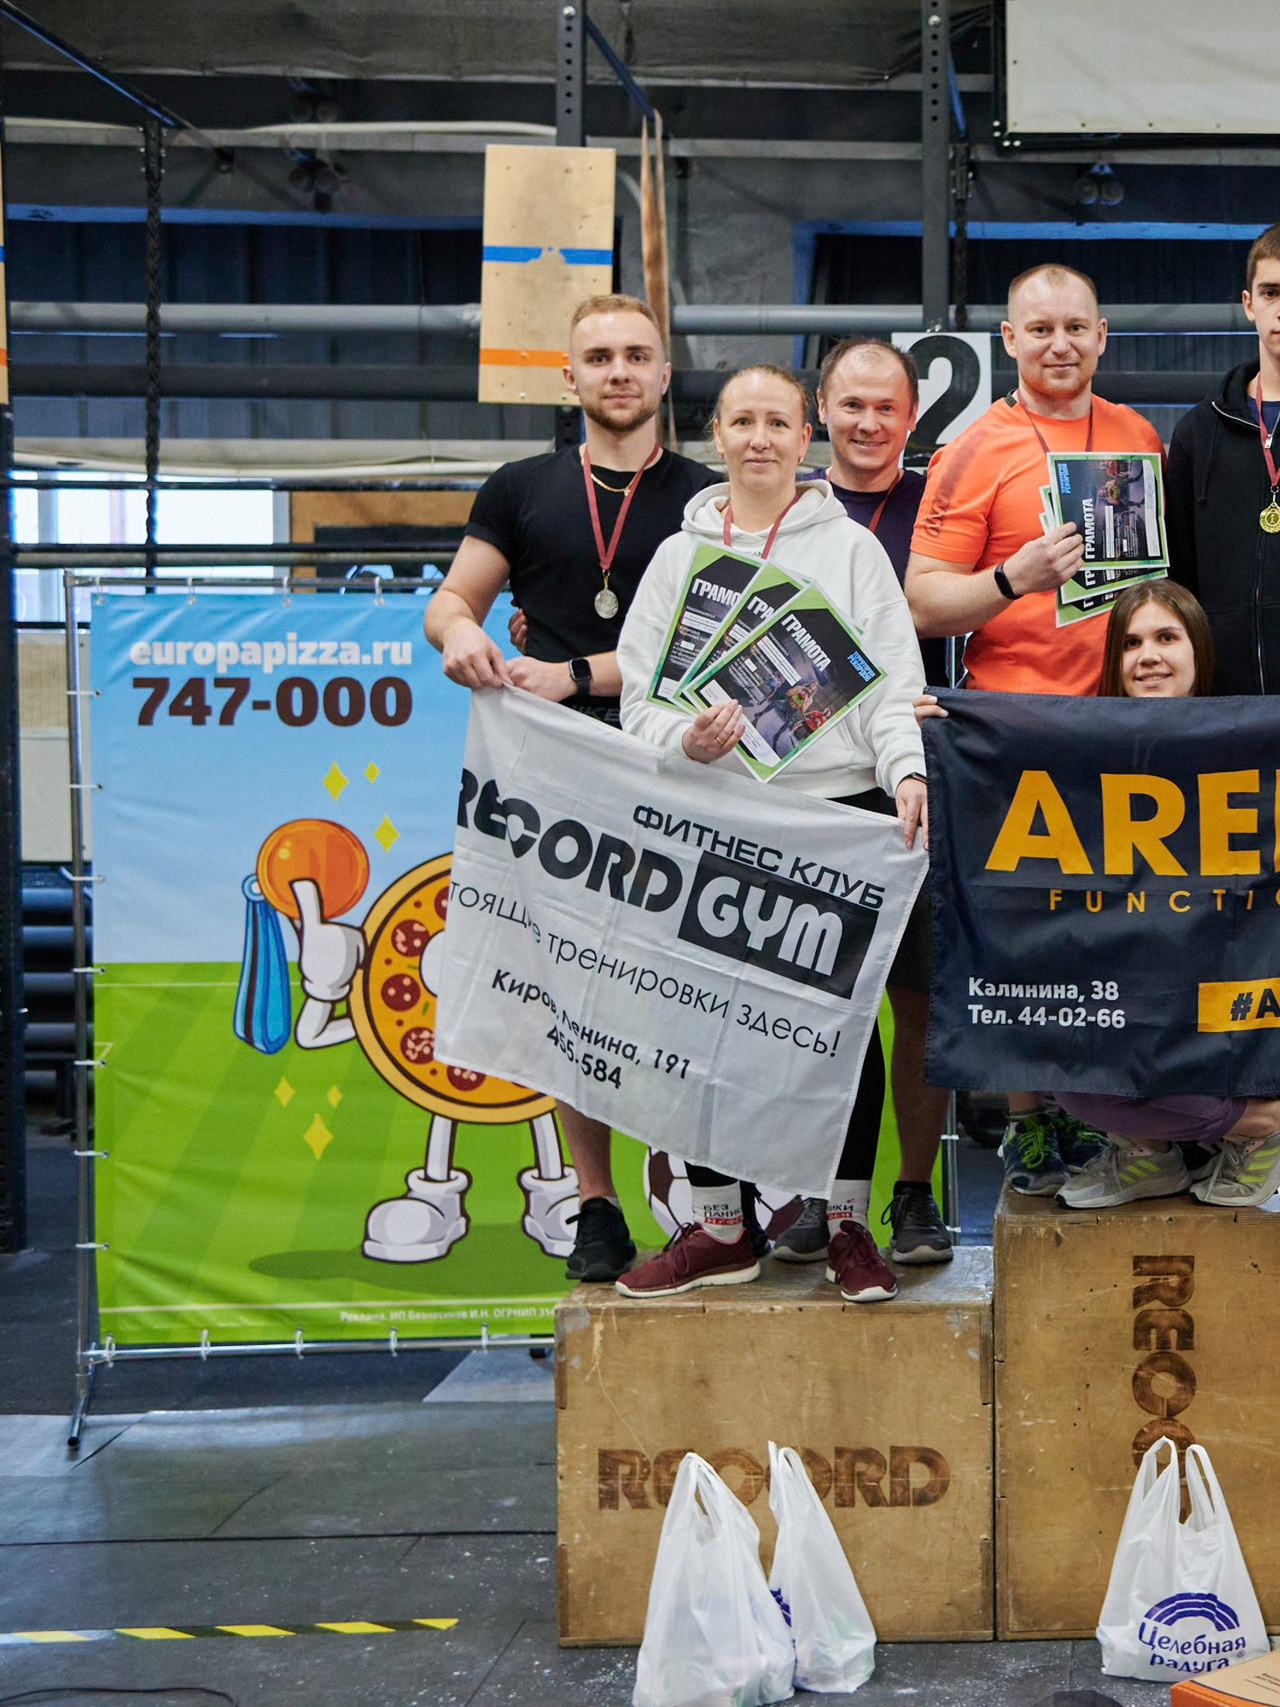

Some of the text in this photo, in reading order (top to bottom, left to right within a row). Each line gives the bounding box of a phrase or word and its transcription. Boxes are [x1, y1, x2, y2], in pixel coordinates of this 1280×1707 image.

[903, 335, 981, 467] 2
[1081, 497, 1096, 560] ГРАМОТА
[690, 578, 743, 606] ГРАМО
[130, 632, 412, 674] europapizza.ru
[780, 613, 833, 672] ГРАМОТА
[132, 676, 413, 727] 747-000
[633, 804, 886, 910] ФИТНЕС КЛУБ
[548, 932, 730, 1019] тренировки
[736, 1003, 842, 1058] здесь!
[967, 977, 1120, 1003] Калинина, 38
[491, 968, 560, 1019] Киров,
[653, 1048, 691, 1080] 191
[967, 1003, 1126, 1029] Тел. 44-02-66
[493, 1307, 537, 1318] ОГРНИП
[1131, 1255, 1197, 1522] RECO
[1137, 1621, 1247, 1656] Целебная
[1150, 1652, 1230, 1674] радуга
